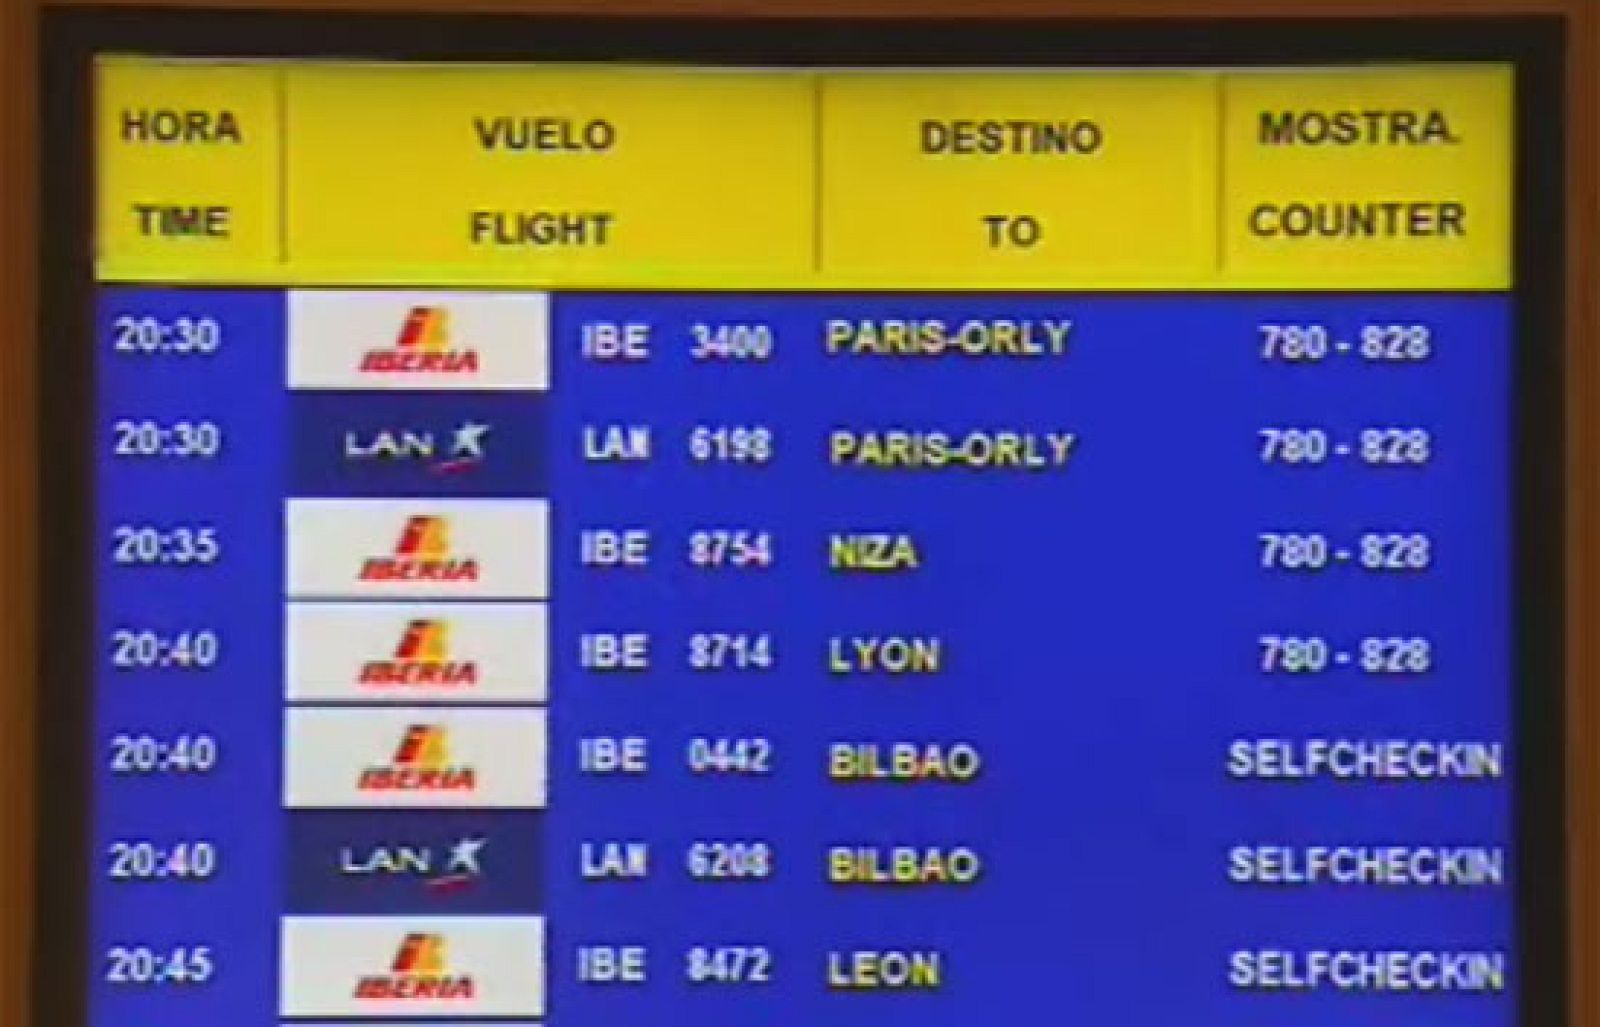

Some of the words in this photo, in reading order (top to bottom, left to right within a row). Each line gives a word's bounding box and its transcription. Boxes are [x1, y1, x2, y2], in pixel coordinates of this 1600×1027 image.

[121, 110, 242, 144] HORA
[474, 118, 616, 152] VUELO
[920, 120, 1103, 155] DESTINO
[134, 204, 230, 239] TIME
[469, 212, 614, 247] FLIGHT
[982, 216, 1042, 249] TO
[1248, 204, 1467, 239] COUNTER
[113, 317, 221, 355] 20:30
[582, 326, 650, 358] IBE
[826, 320, 1073, 355] PARIS-ORLY
[1259, 325, 1328, 360] 780
[1360, 325, 1430, 360] 828
[359, 350, 479, 373] IBERIA
[113, 421, 221, 457] 20:30
[345, 432, 434, 457] LAN
[582, 427, 650, 460] LAN
[830, 433, 1074, 467] PARIS-ORLY
[1259, 428, 1328, 463] 780
[1360, 428, 1430, 463] 828
[113, 528, 220, 563] 20:35
[581, 532, 650, 566] IBE
[689, 532, 772, 566] 8754
[829, 535, 918, 569] NIZA
[1259, 533, 1328, 568] 780
[1360, 533, 1430, 568] 828
[358, 559, 479, 582] IBERIA
[112, 633, 219, 668] 20:40
[580, 635, 650, 668] IBE
[688, 635, 773, 668] 8714
[828, 638, 940, 672] LYON
[1259, 637, 1328, 672] 780
[1360, 637, 1430, 672] 828
[358, 663, 477, 686] IBERIA
[110, 736, 216, 771] 20:40
[579, 738, 647, 773] IBE
[688, 739, 771, 773] 0442
[828, 744, 980, 778] BILBAO
[1228, 742, 1503, 778] SELFCHECKIN
[357, 768, 475, 790] IBERIA
[108, 843, 215, 878] 20:40
[341, 849, 430, 873] LAN
[580, 844, 648, 878] LAN
[828, 848, 981, 882] BILBAO
[1229, 848, 1504, 882] SELFCHECKIN
[106, 948, 212, 983] 20:45
[577, 949, 646, 982] IBE
[687, 950, 770, 983] 8472
[828, 952, 940, 987] LEON
[1229, 952, 1504, 990] SELFCHECKIN
[353, 977, 475, 999] IBERIA
